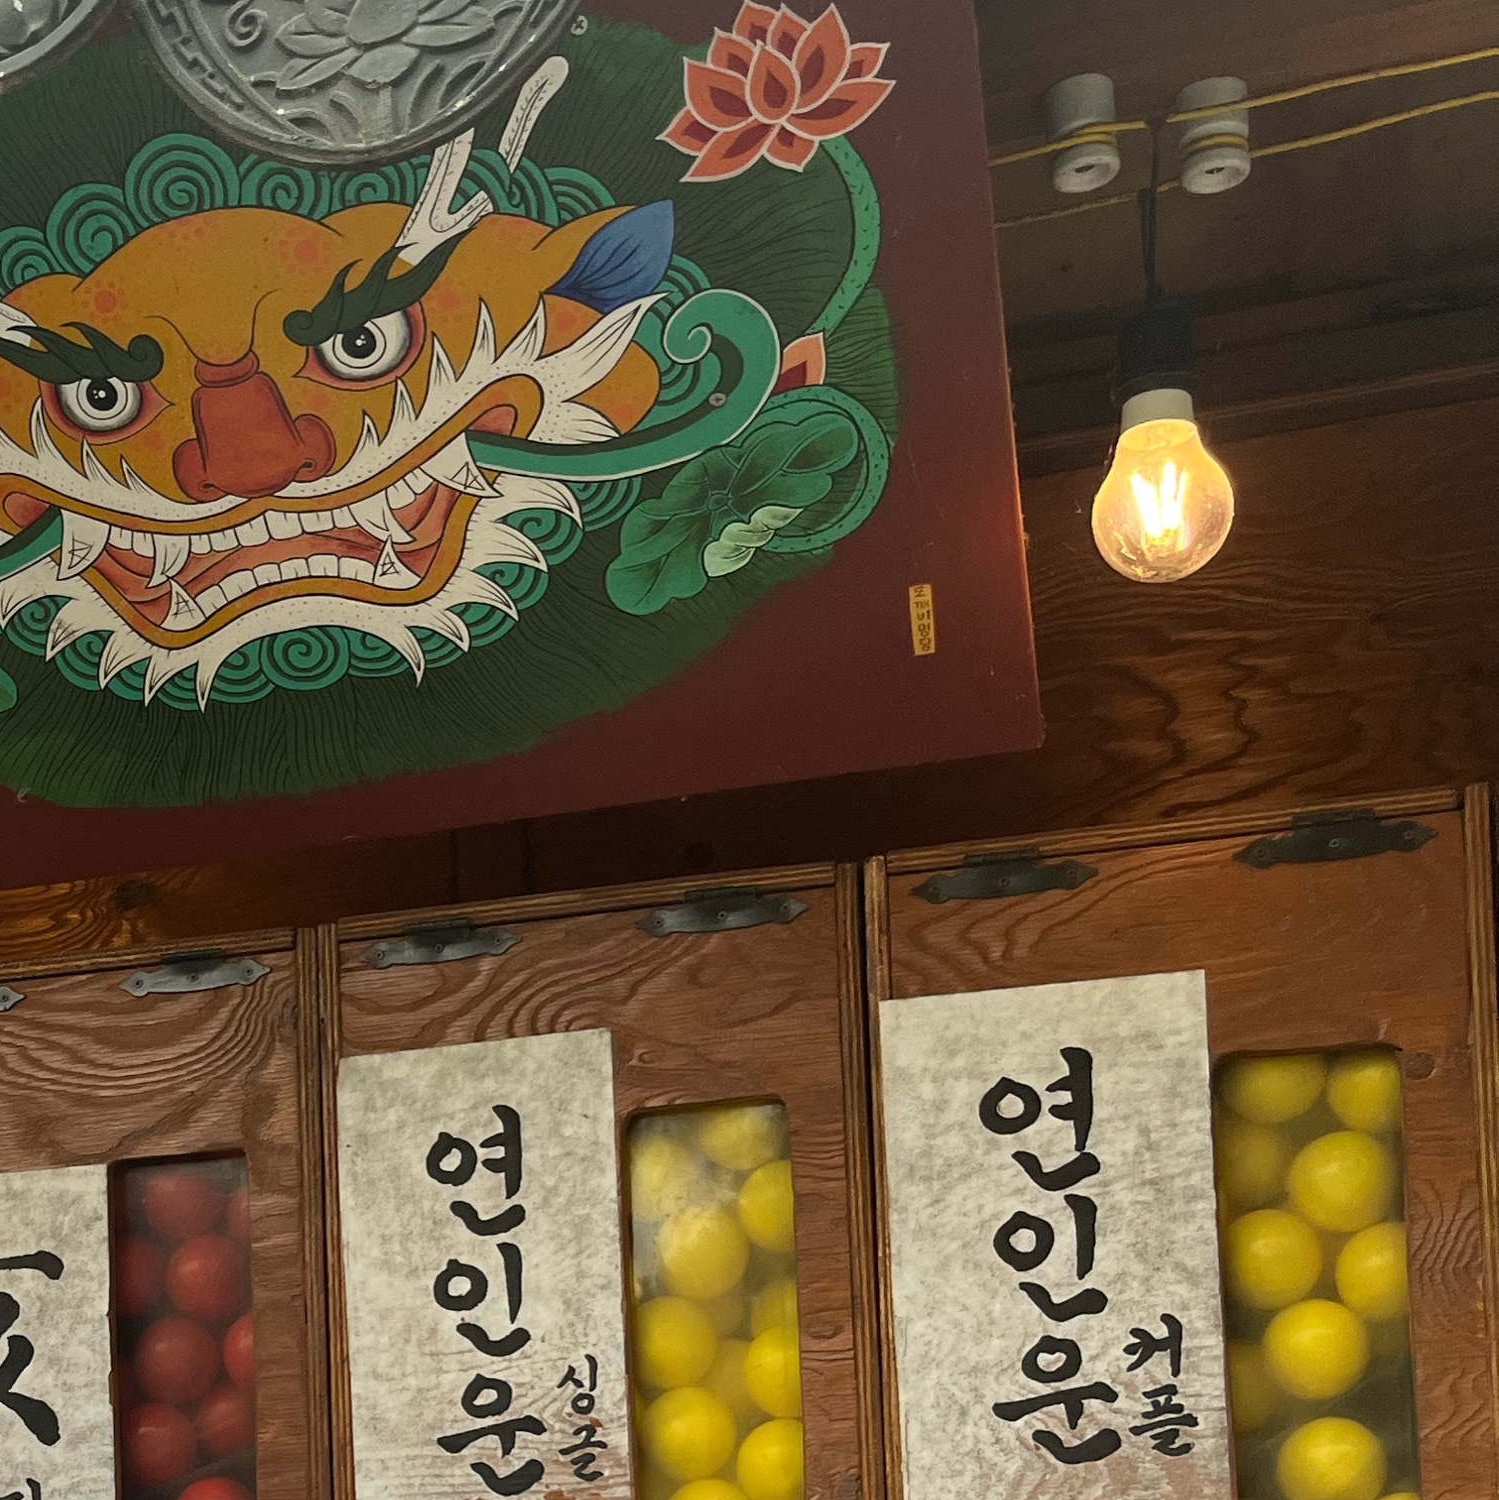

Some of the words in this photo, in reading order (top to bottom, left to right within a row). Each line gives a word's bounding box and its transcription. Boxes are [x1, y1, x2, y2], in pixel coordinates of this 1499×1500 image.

[426, 1104, 547, 1497] 연인운
[979, 1046, 1122, 1465] 연인운
[1122, 1313, 1199, 1457] 커플
[557, 1353, 609, 1483] 싱글
